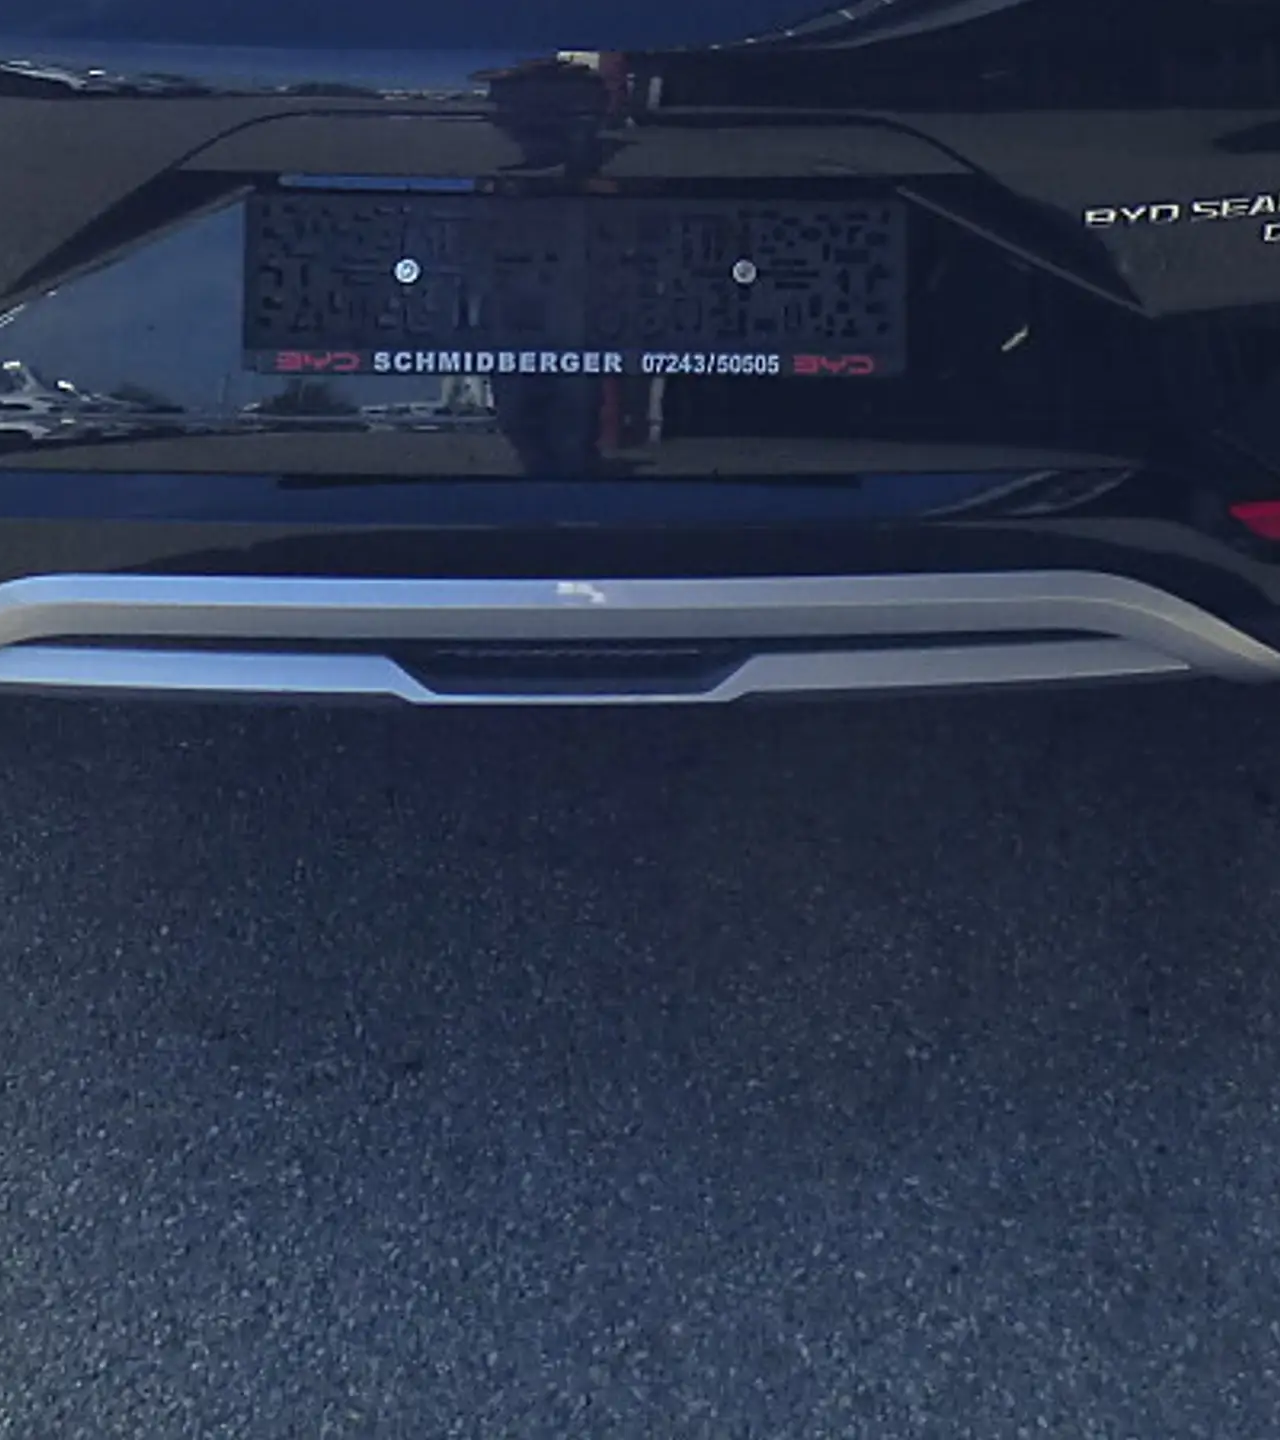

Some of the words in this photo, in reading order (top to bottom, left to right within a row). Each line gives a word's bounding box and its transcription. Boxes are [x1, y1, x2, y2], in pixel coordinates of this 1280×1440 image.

[1084, 203, 1180, 229] BYD
[275, 350, 362, 372] BYD
[373, 350, 624, 373] SCHMIDBERGER
[641, 352, 781, 375] 07243/50505
[792, 353, 876, 375] BYD
